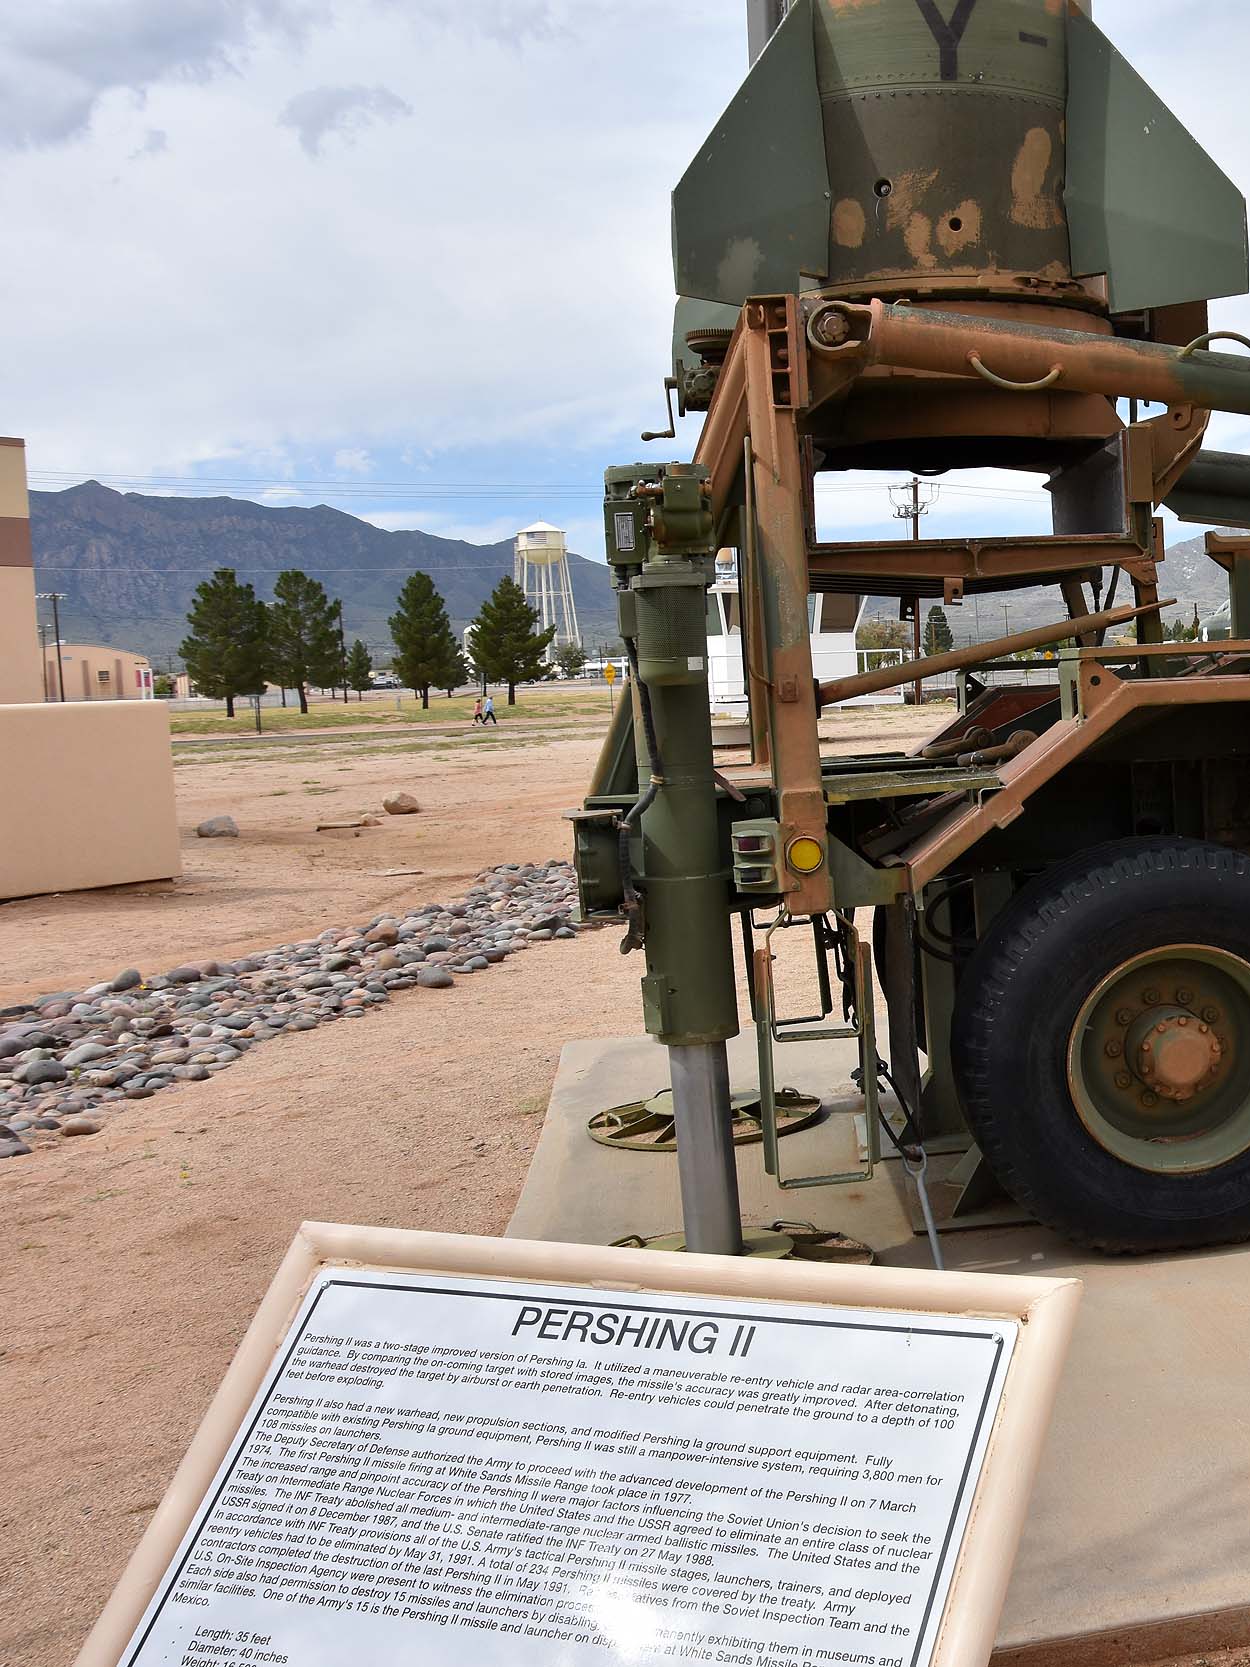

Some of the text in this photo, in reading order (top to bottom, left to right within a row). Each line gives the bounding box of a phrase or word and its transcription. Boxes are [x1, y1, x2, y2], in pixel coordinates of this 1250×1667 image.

[513, 1306, 755, 1357] PERSHING II
[284, 1368, 384, 1390] feet before exploding.
[291, 1356, 955, 1430] the warhead destroyed the target by airburst or earth penetration. Re-entry vehicles could penetrate the ground to a depth of 100
[303, 1332, 345, 1347] Pershing
[353, 1339, 373, 1348] was
[373, 1341, 381, 1349] a
[382, 1340, 430, 1355] two-stage
[430, 1344, 478, 1358] improved
[479, 1351, 515, 1362] version
[516, 1353, 529, 1363] of
[528, 1354, 574, 1370] Pershing
[593, 1360, 603, 1371] It
[603, 1362, 643, 1374] utilized
[642, 1367, 651, 1375] a
[652, 1368, 728, 1382] maneuverable
[729, 1375, 774, 1389] re-entry
[776, 1378, 815, 1390] vehicle
[816, 1382, 840, 1393] and
[840, 1384, 873, 1395] radar
[873, 1388, 965, 1403] area-correlation
[261, 1418, 382, 1441] 108 missiles on launchers.
[272, 1393, 315, 1409] Pershing
[323, 1399, 344, 1410] also
[344, 1400, 366, 1412] had
[364, 1404, 373, 1413] a
[373, 1405, 396, 1415] new
[396, 1408, 440, 1422] warhead,
[442, 1413, 466, 1423] new
[464, 1415, 520, 1429] propulsion
[521, 1421, 567, 1436] sections,
[570, 1426, 593, 1437] and
[592, 1429, 642, 1442] modified
[642, 1432, 691, 1449] Pershing
[704, 1441, 747, 1453] ground
[747, 1445, 792, 1458] support
[794, 1450, 858, 1464] equipment.
[864, 1454, 894, 1470] Fully
[248, 1443, 272, 1456] 1974.
[278, 1446, 297, 1458] The
[297, 1449, 318, 1461] first
[317, 1451, 362, 1468] Pershing
[370, 1458, 407, 1471] missile
[407, 1461, 434, 1477] firing
[434, 1465, 447, 1476] at
[448, 1466, 478, 1479] White
[479, 1469, 513, 1484] Sands
[514, 1474, 552, 1488] Missile
[553, 1478, 589, 1494] Range
[590, 1483, 616, 1495] took
[615, 1486, 648, 1500] place
[649, 1489, 661, 1501] in
[664, 1491, 692, 1505] 1977.
[221, 1495, 714, 1567] USSR signed it on 8 December 1987, and the U.S. Senate ratified the INF Treaty on 27 May 1988.
[235, 1469, 934, 1560] Treaty on Intermediate Range Nuclear Forces in which the United States and the USSR agreed to eliminate an entire class of nuclear
[171, 1591, 210, 1607] Mexico.
[193, 1549, 593, 1612] U.S. On-Site Inspection Agency were present to witness the elimination proces
[187, 1639, 289, 1664] Diameter: 40 inches
[194, 1625, 272, 1646] Length: 35 feet
